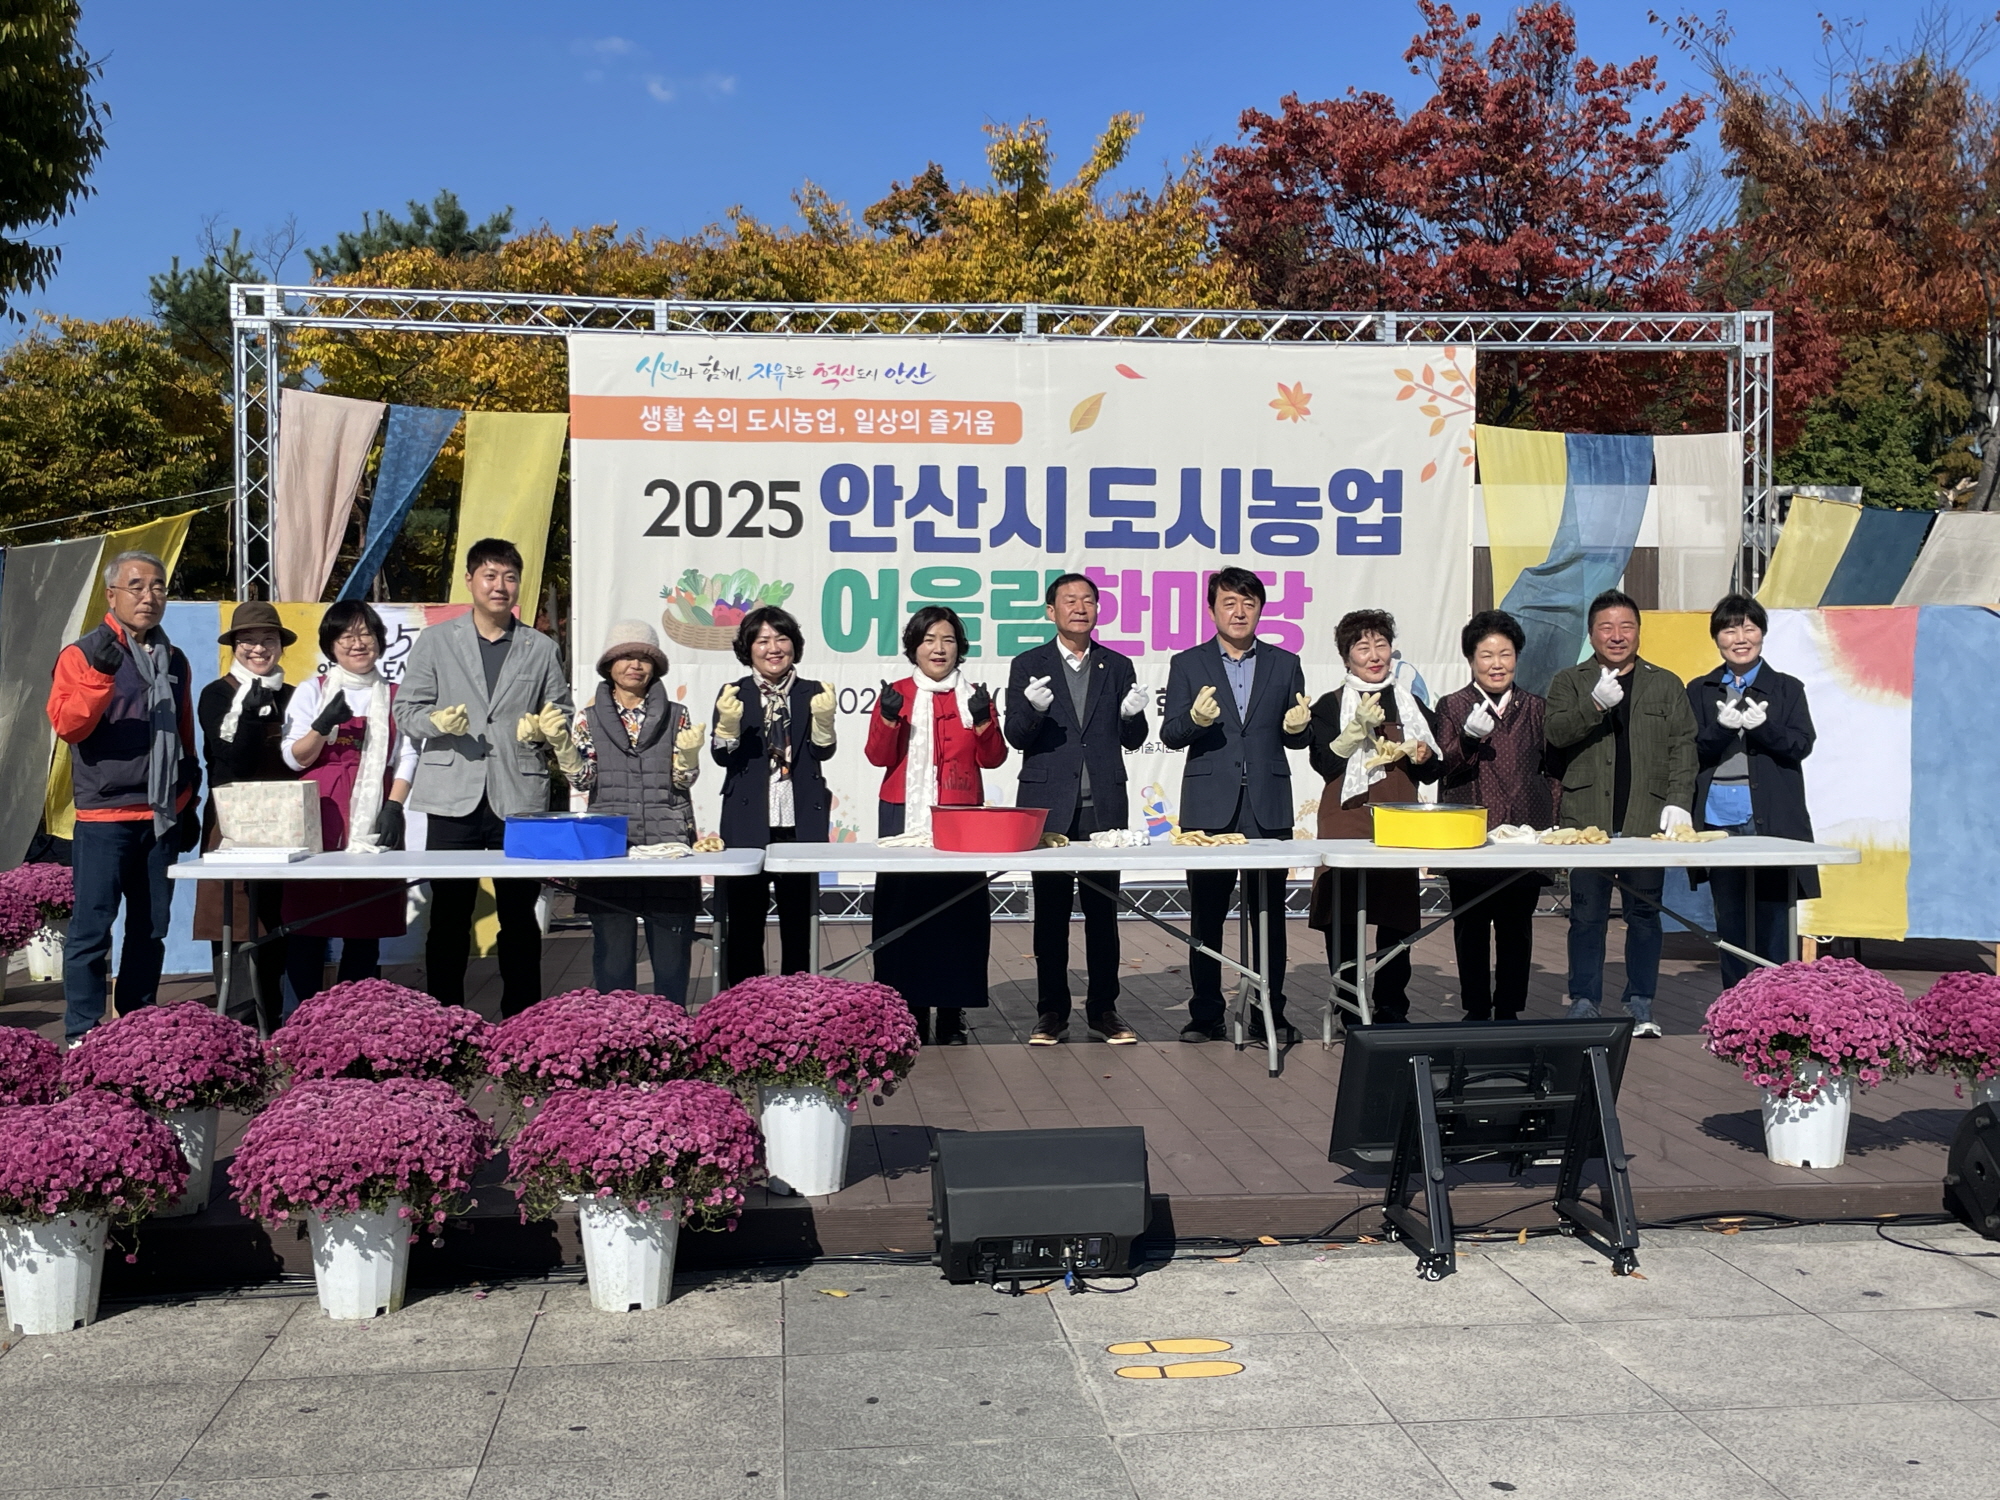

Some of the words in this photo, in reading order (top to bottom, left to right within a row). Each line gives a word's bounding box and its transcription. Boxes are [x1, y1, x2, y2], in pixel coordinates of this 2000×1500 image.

[635, 351, 697, 387] 시민과
[698, 355, 742, 382] 함께,
[747, 363, 806, 391] 자유로운
[813, 363, 878, 391] 혁신도시
[884, 362, 937, 385] 안산
[640, 405, 685, 432] 생활
[692, 406, 738, 433] 속의
[746, 407, 845, 435] 도시농업,
[854, 408, 920, 434] 일상의
[928, 409, 995, 435] 즐거움
[643, 479, 803, 539] 2025
[820, 463, 1066, 553] 안산시
[1085, 467, 1403, 556] 도시농업
